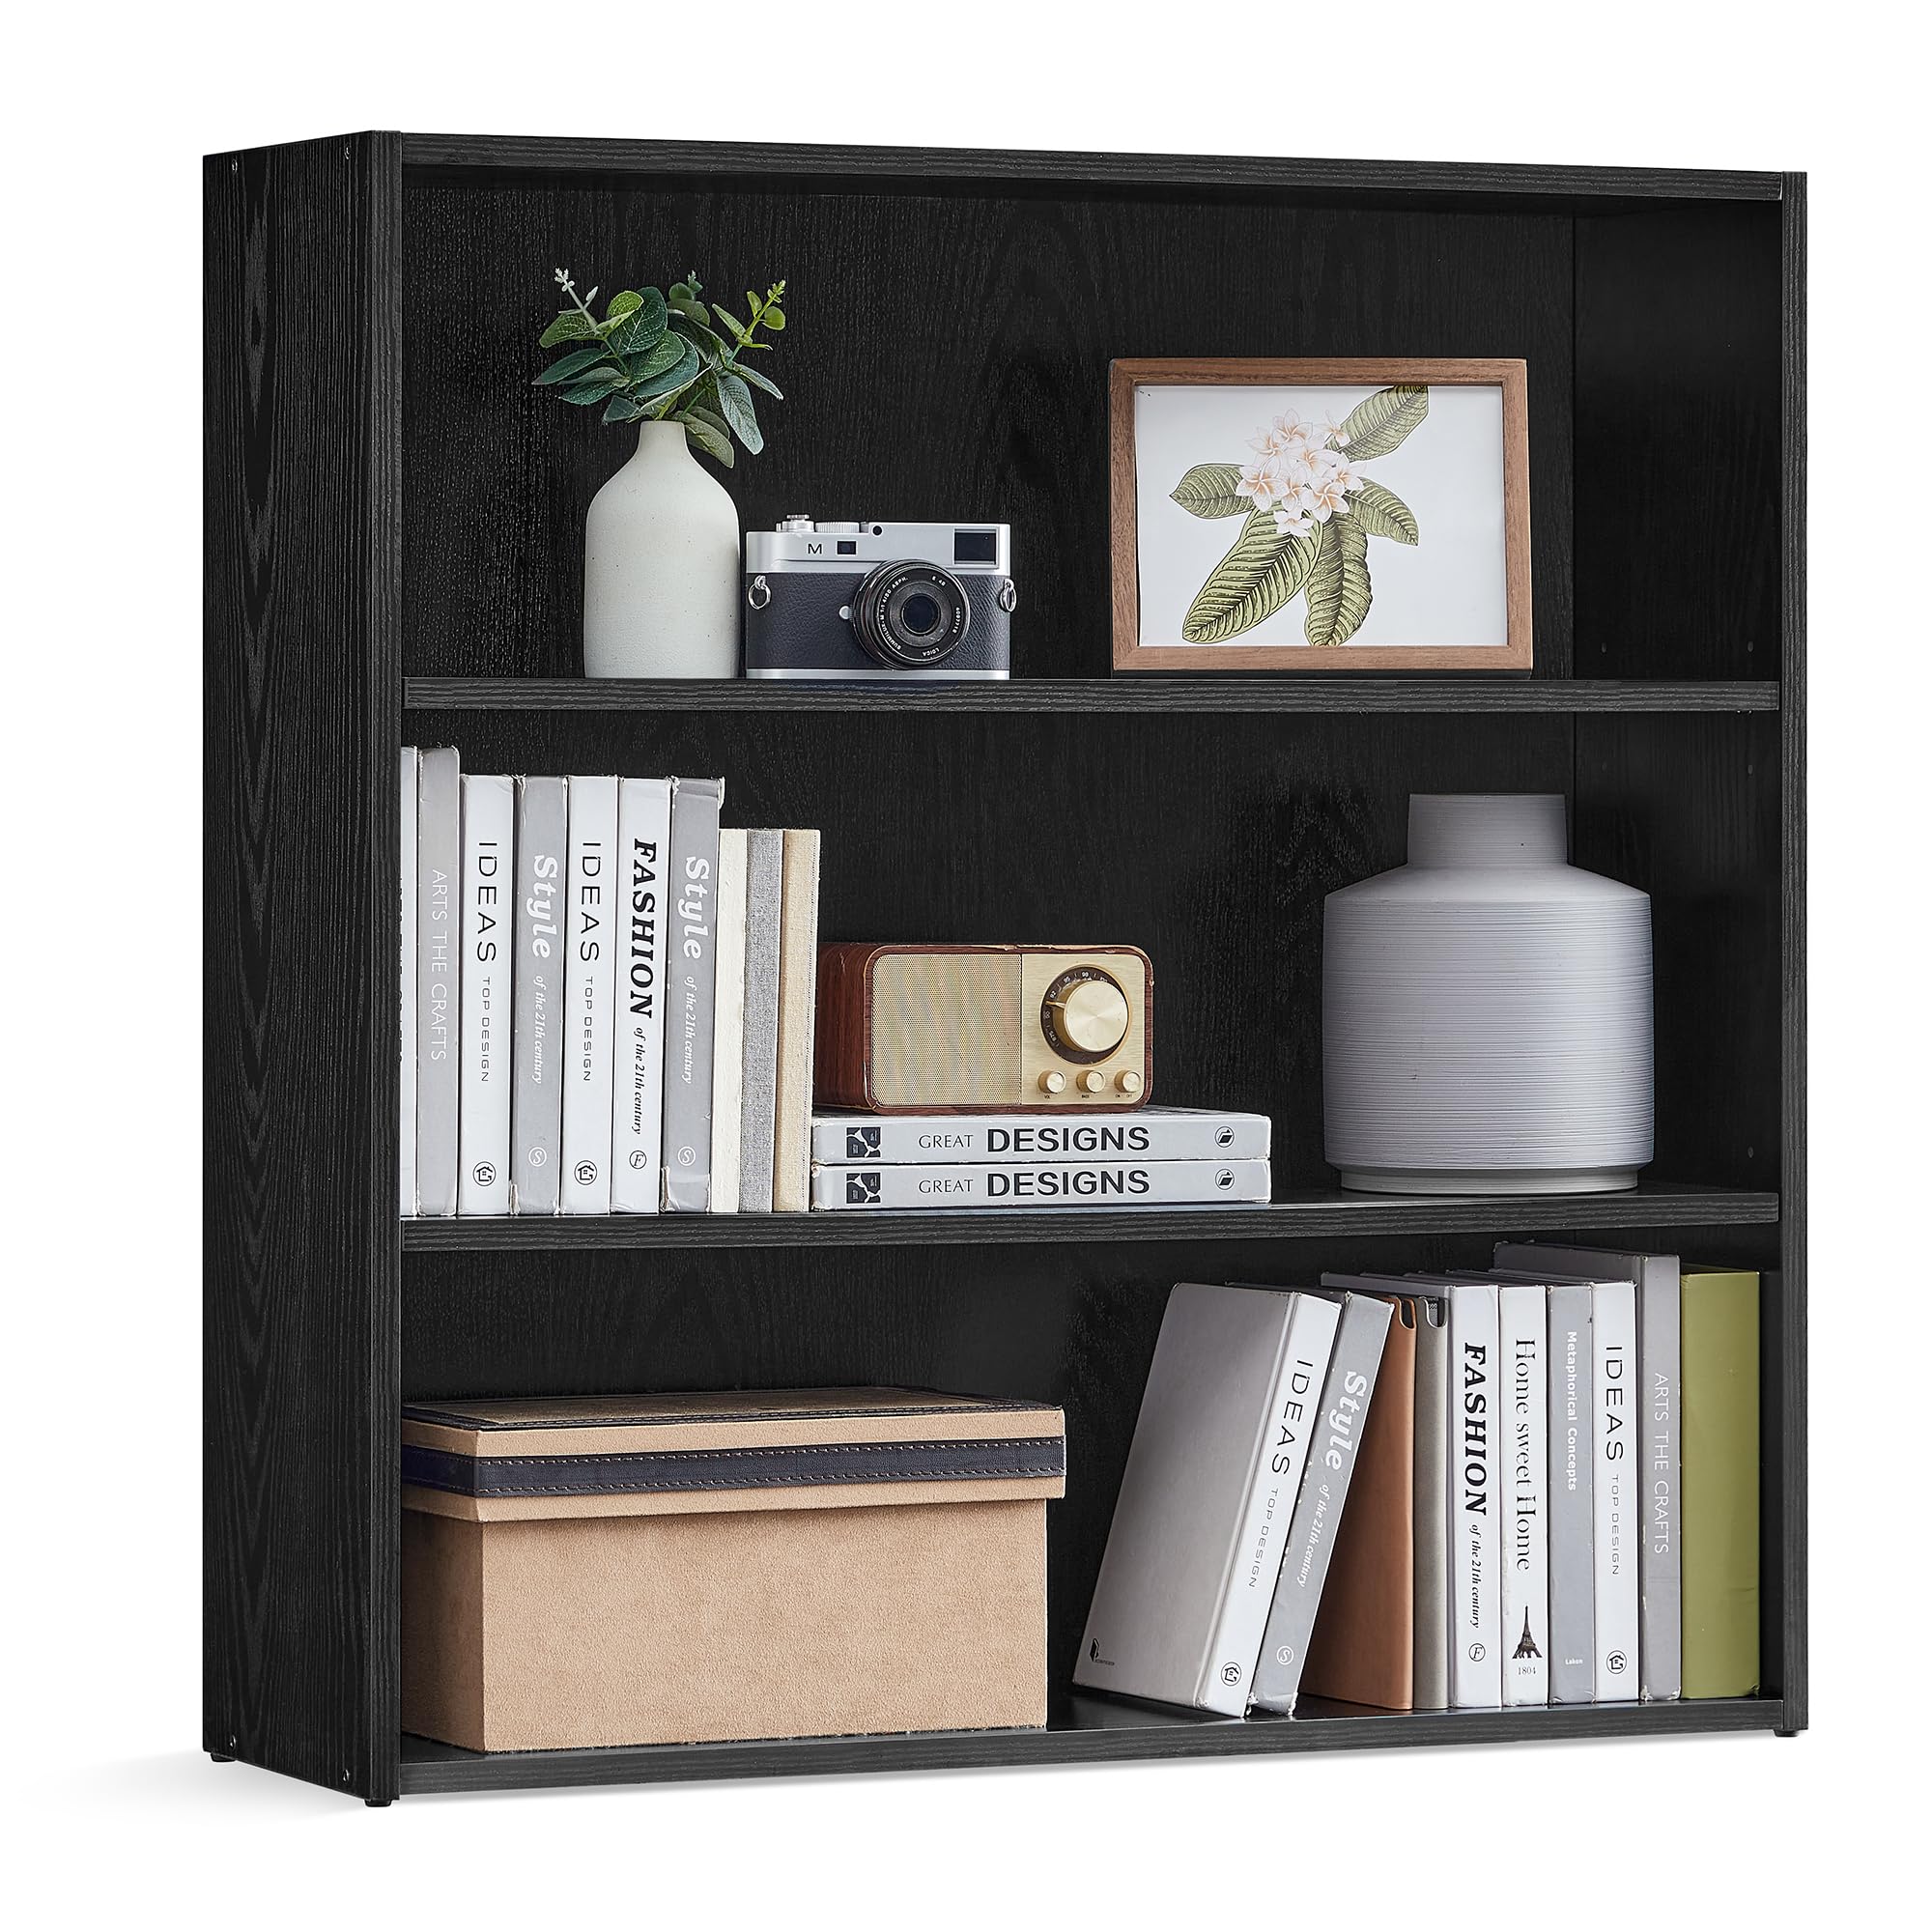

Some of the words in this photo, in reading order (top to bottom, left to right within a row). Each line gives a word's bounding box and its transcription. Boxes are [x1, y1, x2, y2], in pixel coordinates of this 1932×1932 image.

[808, 543, 822, 554] M
[433, 869, 447, 920] ARTS
[477, 842, 497, 962] IDEAS
[526, 855, 557, 957] Style
[581, 843, 601, 961] IDEAS
[678, 857, 709, 958] Style
[630, 838, 656, 1018] FASHION
[432, 931, 446, 972] THE
[482, 976, 491, 1010] TOP
[533, 976, 546, 990] of
[534, 991, 547, 1011] the
[584, 976, 593, 1010] TOP
[684, 976, 696, 991] of
[686, 991, 697, 1012] the
[432, 984, 446, 1060] CRAFTS
[534, 1011, 547, 1039] 21th
[633, 1027, 646, 1042] of
[685, 1011, 696, 1040] 21th
[481, 1016, 491, 1083] DESIGN
[531, 1039, 544, 1085] century
[582, 1016, 592, 1082] DESIGN
[635, 1043, 646, 1062] the
[681, 1039, 695, 1085] century
[634, 1063, 646, 1091] 21th
[631, 1092, 642, 1135] century
[919, 1135, 973, 1148] GREAT
[988, 1127, 1149, 1151] DESIGNS
[919, 1179, 973, 1193] GREAT
[988, 1170, 1149, 1196] DESIGNS
[1517, 1340, 1535, 1413] Home
[1565, 1331, 1577, 1421] Metaphorical
[1655, 1374, 1668, 1420] ARTS
[1271, 1359, 1313, 1475] IDEAS
[1326, 1371, 1367, 1470] Style
[1606, 1347, 1624, 1461] IDEAS
[1464, 1343, 1487, 1516] FASHION
[1655, 1431, 1668, 1469] THE
[1517, 1424, 1532, 1487] sweet
[1566, 1427, 1577, 1491] Concepts
[1266, 1488, 1279, 1520] TOP
[1315, 1498, 1327, 1520] the
[1319, 1484, 1330, 1501] of
[1468, 1524, 1482, 1539] of
[1517, 1496, 1536, 1570] Home
[1655, 1481, 1668, 1553] CRAFTS
[1249, 1526, 1268, 1587] DESIGN
[1471, 1540, 1482, 1558] the
[1611, 1513, 1620, 1576] DESIGN
[1297, 1546, 1314, 1587] century
[1471, 1559, 1482, 1584] 21th
[1469, 1586, 1480, 1629] century
